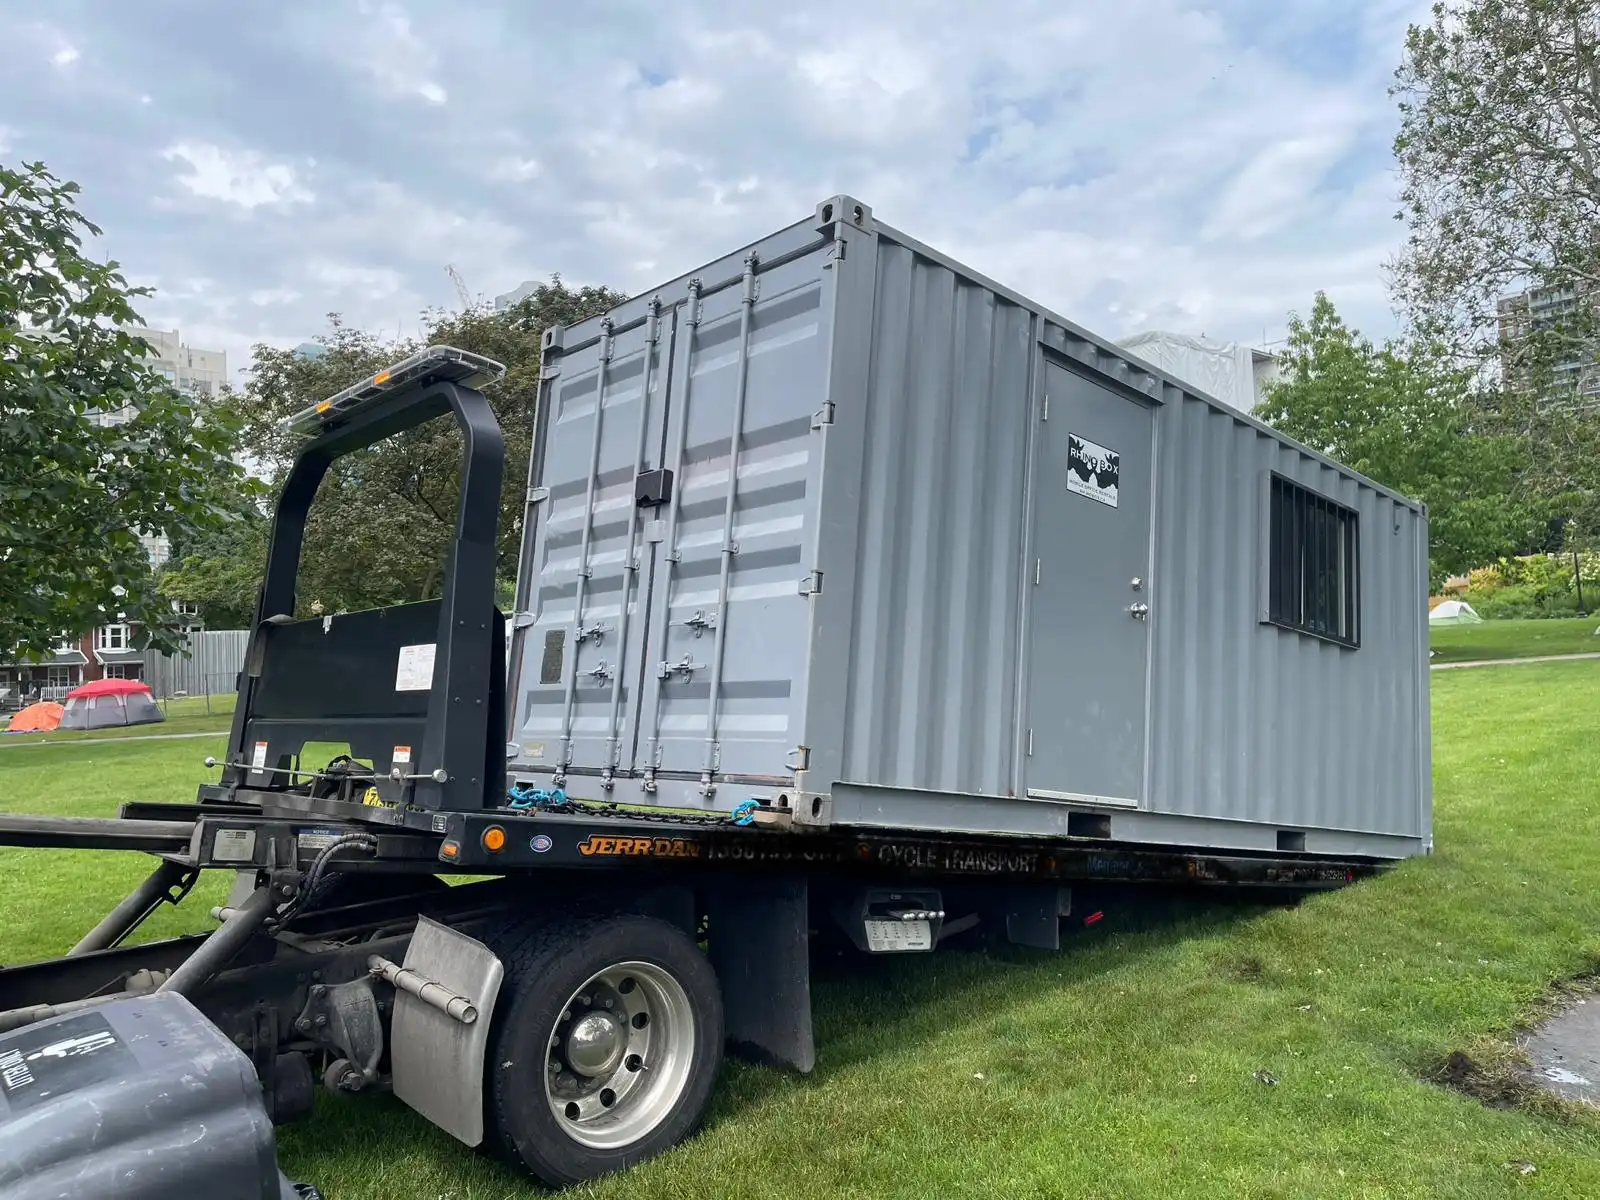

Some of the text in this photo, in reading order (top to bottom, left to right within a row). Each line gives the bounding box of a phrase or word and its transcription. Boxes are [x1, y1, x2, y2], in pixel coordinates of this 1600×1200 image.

[1070, 447, 1119, 475] RHINO BOX
[578, 836, 701, 857] JERR-DAN
[877, 843, 1041, 873] CYCLE TRANSPORT
[3, 1063, 35, 1091] LITTER
